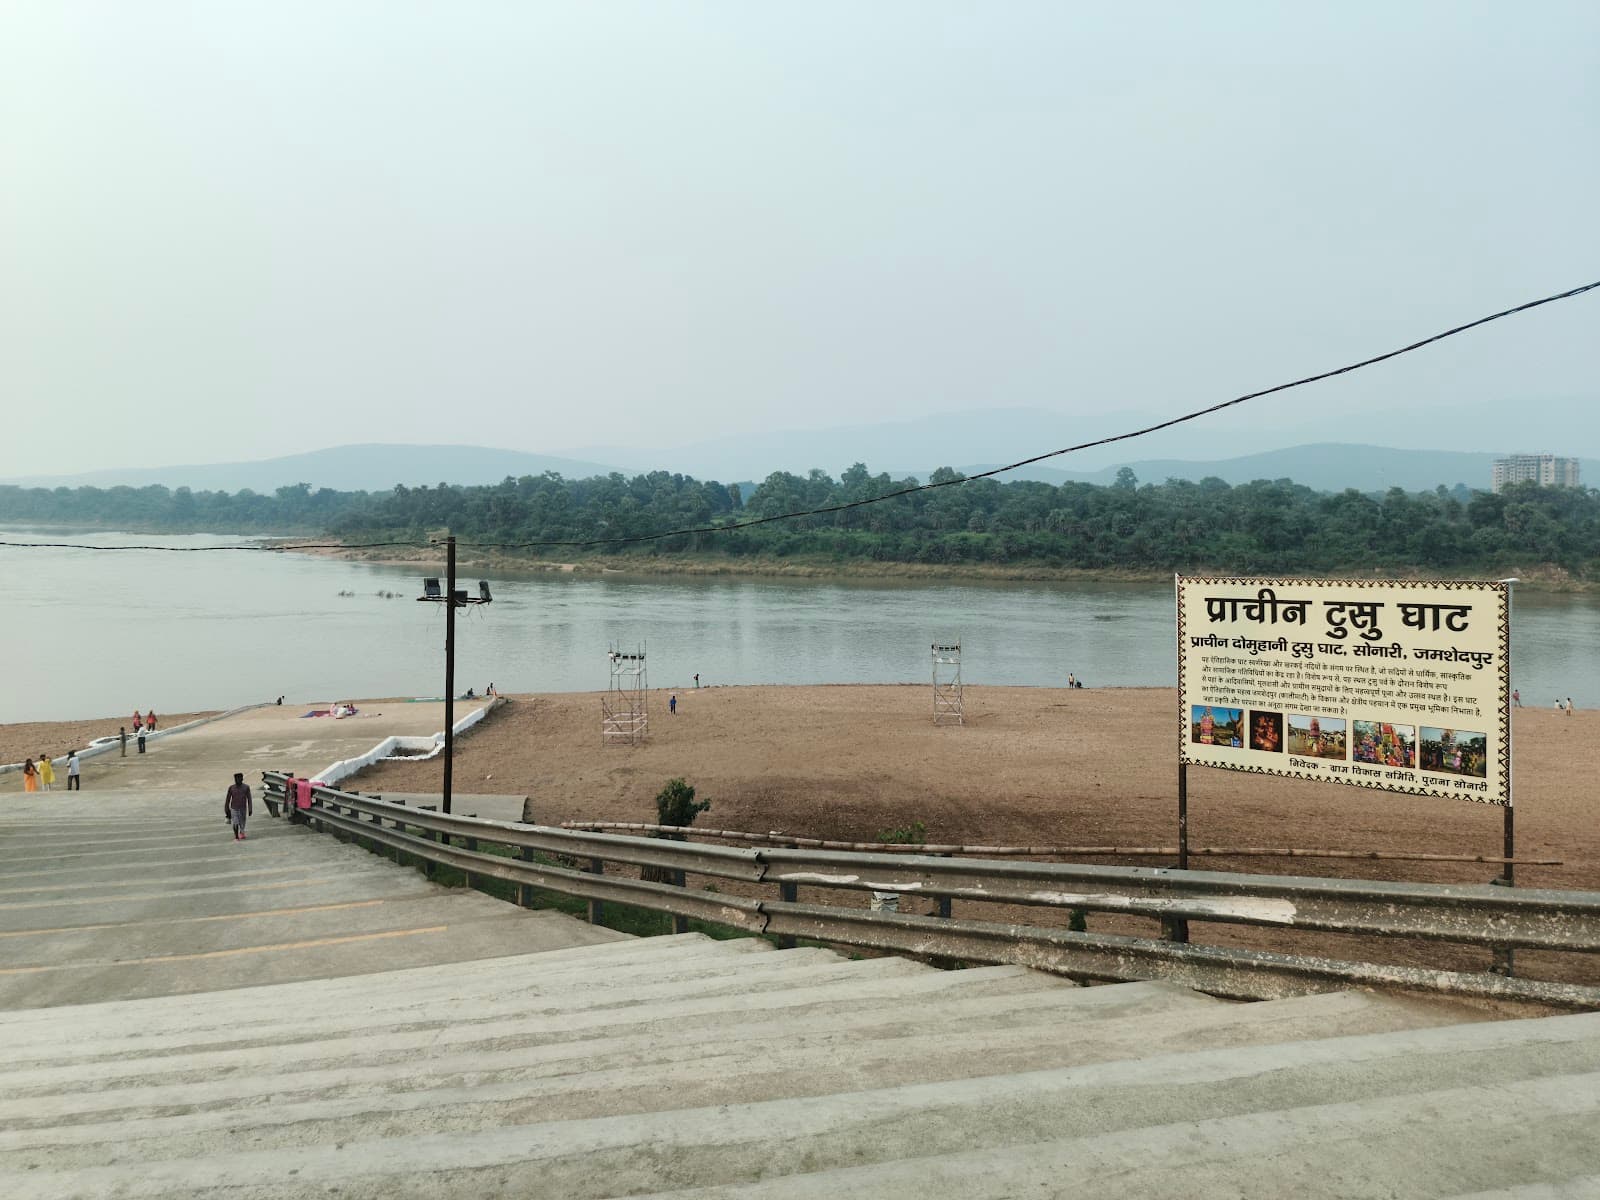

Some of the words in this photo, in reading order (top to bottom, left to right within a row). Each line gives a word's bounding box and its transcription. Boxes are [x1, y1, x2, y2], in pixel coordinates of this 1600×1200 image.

[1204, 588, 1313, 626] प्राचीन
[1323, 601, 1385, 641] टुसु
[1396, 603, 1472, 632] घाट
[1190, 633, 1230, 648] प्राचीन
[1231, 635, 1289, 656] दोमुहानी
[1291, 642, 1314, 659] टुसु
[1317, 643, 1347, 656] घाट,
[1352, 641, 1407, 660] सोनारी,
[1412, 646, 1494, 670] जमशेदपुर
[1201, 656, 1209, 664] यह
[1237, 658, 1247, 666] घाट
[1272, 659, 1282, 669] और
[1304, 661, 1320, 673] नदियों
[1322, 662, 1328, 671] के
[1345, 664, 1353, 675] पर
[1354, 664, 1369, 676] स्थित
[1378, 666, 1386, 677] जो
[1388, 667, 1406, 679] सदियों
[1408, 668, 1414, 678] से
[1201, 673, 1207, 683] से
[1218, 675, 1224, 686] के
[1280, 679, 1290, 689] और
[1292, 681, 1310, 693] ग्रामीण
[1311, 682, 1333, 695] समुदायों
[1334, 683, 1341, 693] के
[1342, 684, 1353, 696] लिए
[1381, 689, 1394, 701] पूजा
[1396, 688, 1407, 699] और
[1408, 691, 1426, 702] उत्सव
[1427, 691, 1441, 705] स्थल
[1453, 695, 1463, 706] इस
[1465, 696, 1477, 707] घाट
[1202, 664, 1211, 675] और
[1265, 668, 1274, 678] का
[1286, 672, 1295, 680] रहा
[1305, 671, 1320, 683] विशेष
[1322, 674, 1333, 685] रूप
[1342, 673, 1351, 686] यह
[1353, 676, 1366, 686] स्थल
[1367, 676, 1378, 687] टुसु
[1378, 677, 1388, 688] पर्व
[1389, 677, 1396, 688] के
[1397, 677, 1414, 690] दौरान
[1416, 679, 1434, 690] विशेष
[1434, 681, 1448, 694] रूप
[1201, 685, 1209, 693] का
[1209, 683, 1236, 697] ऐतिहासिक
[1252, 687, 1277, 700] जमशेदपुर
[1310, 692, 1317, 701] के
[1318, 693, 1337, 705] विकास
[1339, 695, 1350, 707] और
[1351, 696, 1367, 706] क्षेत्रीय
[1368, 698, 1388, 709] पहचान
[1397, 702, 1408, 711] एक
[1409, 701, 1426, 713] प्रमुख
[1427, 703, 1449, 714] भूमिका
[1450, 704, 1473, 716] निभाता
[1214, 695, 1229, 705] प्रकृति
[1230, 695, 1240, 705] और
[1299, 702, 1312, 713] देखा
[1321, 703, 1339, 714] सकता
[1289, 757, 1319, 770] निवेदक
[1328, 764, 1350, 774] ग्राम
[1351, 765, 1382, 778] विकास
[1384, 770, 1418, 784] समिति,
[1421, 776, 1451, 787] पुराना
[1453, 778, 1489, 792] सोनारी
